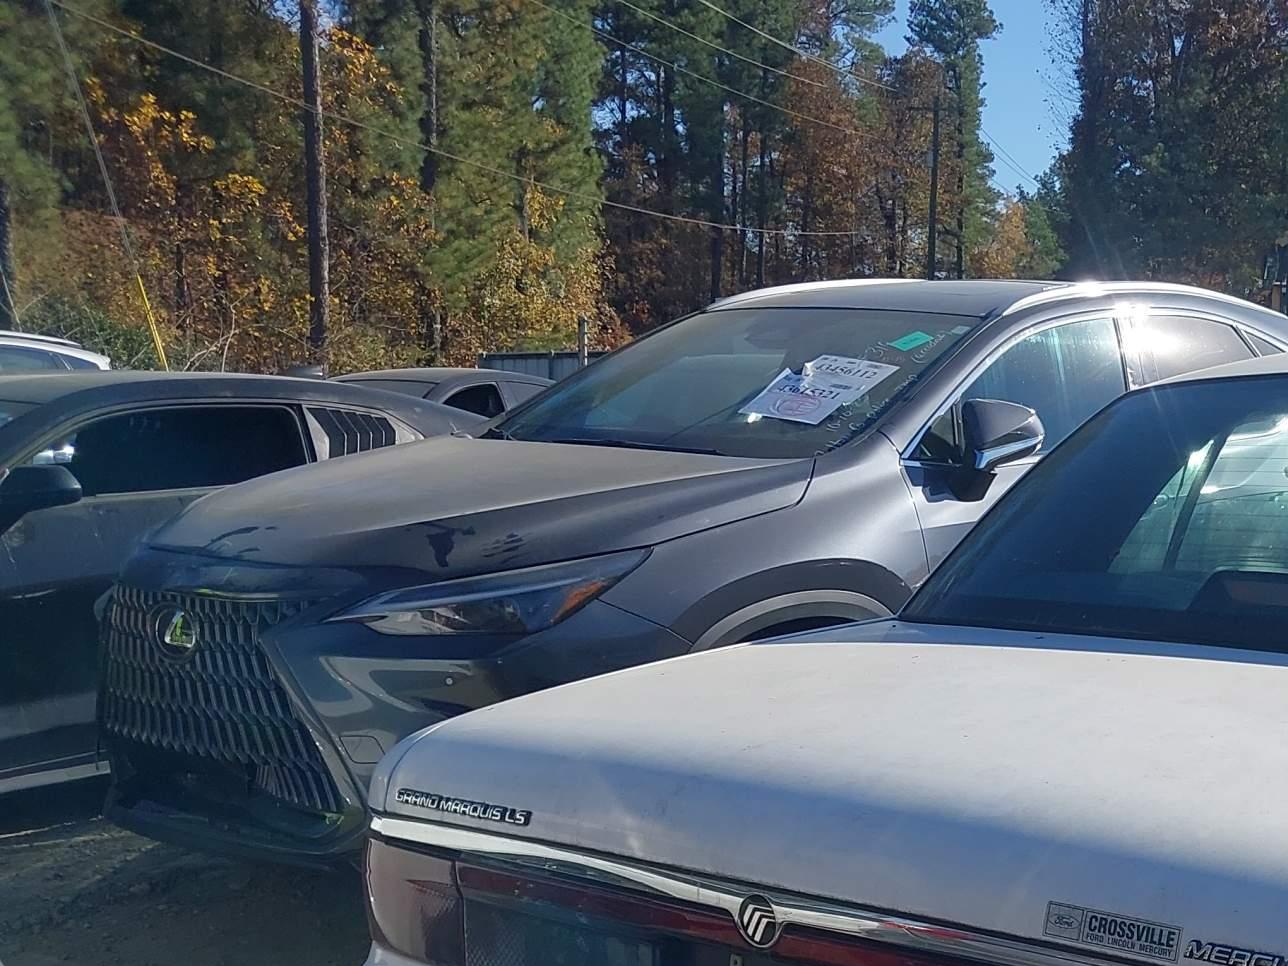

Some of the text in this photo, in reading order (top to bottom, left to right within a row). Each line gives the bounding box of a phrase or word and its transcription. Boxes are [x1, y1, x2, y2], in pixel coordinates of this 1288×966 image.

[395, 789, 527, 825] GRAND MARQUIS LS
[1086, 932, 1172, 958] FORD LINCOLN MERCURY
[1088, 914, 1177, 948] CROSSVILLE
